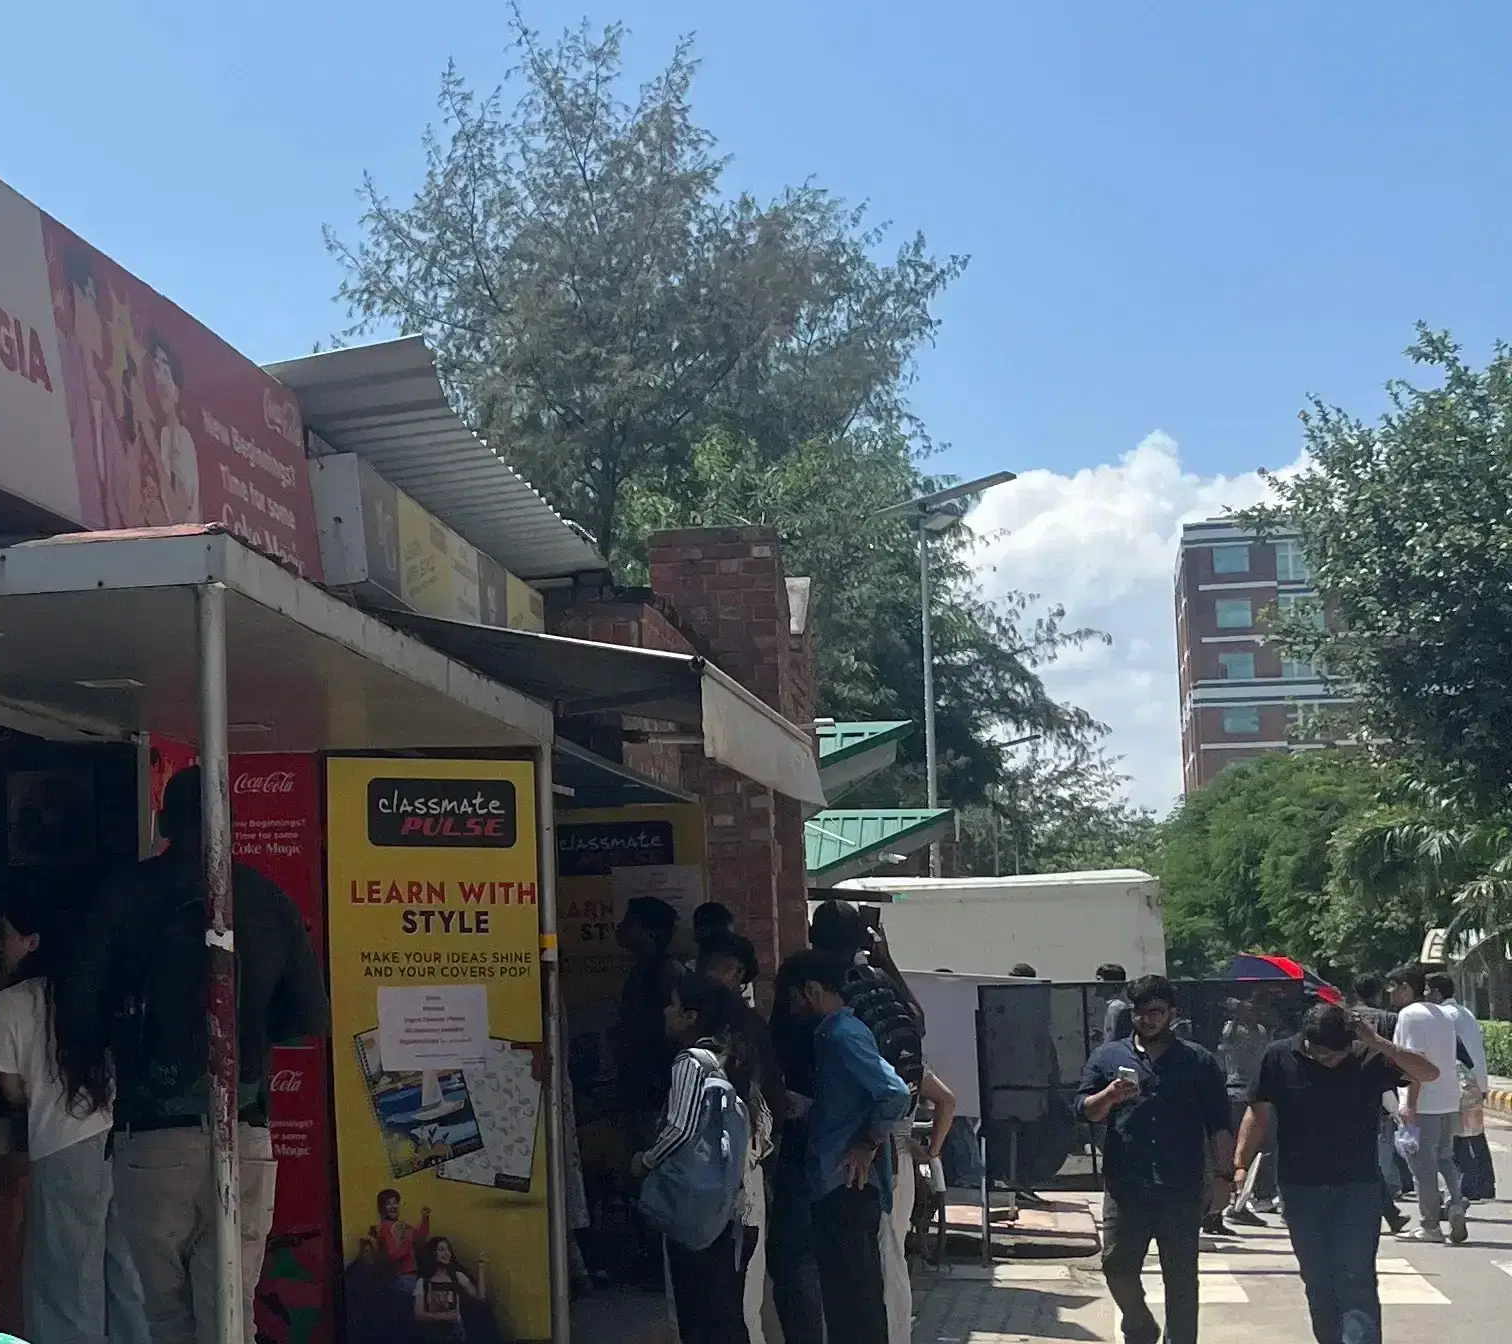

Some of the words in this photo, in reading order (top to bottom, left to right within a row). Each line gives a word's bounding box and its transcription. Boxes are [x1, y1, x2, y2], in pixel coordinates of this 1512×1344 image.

[378, 789, 506, 815] classmate
[400, 817, 505, 836] PULSE
[351, 880, 446, 905] LEARN
[458, 882, 537, 905] WITH
[402, 910, 489, 934] STYLE
[361, 951, 399, 963] MAKE
[404, 951, 441, 963] YOUR
[447, 951, 487, 963] IDEAS
[492, 951, 532, 964] SHINE
[364, 966, 393, 977] AND
[398, 966, 436, 977] YOUR
[441, 966, 495, 977] COVERS
[500, 966, 531, 977] POP!
